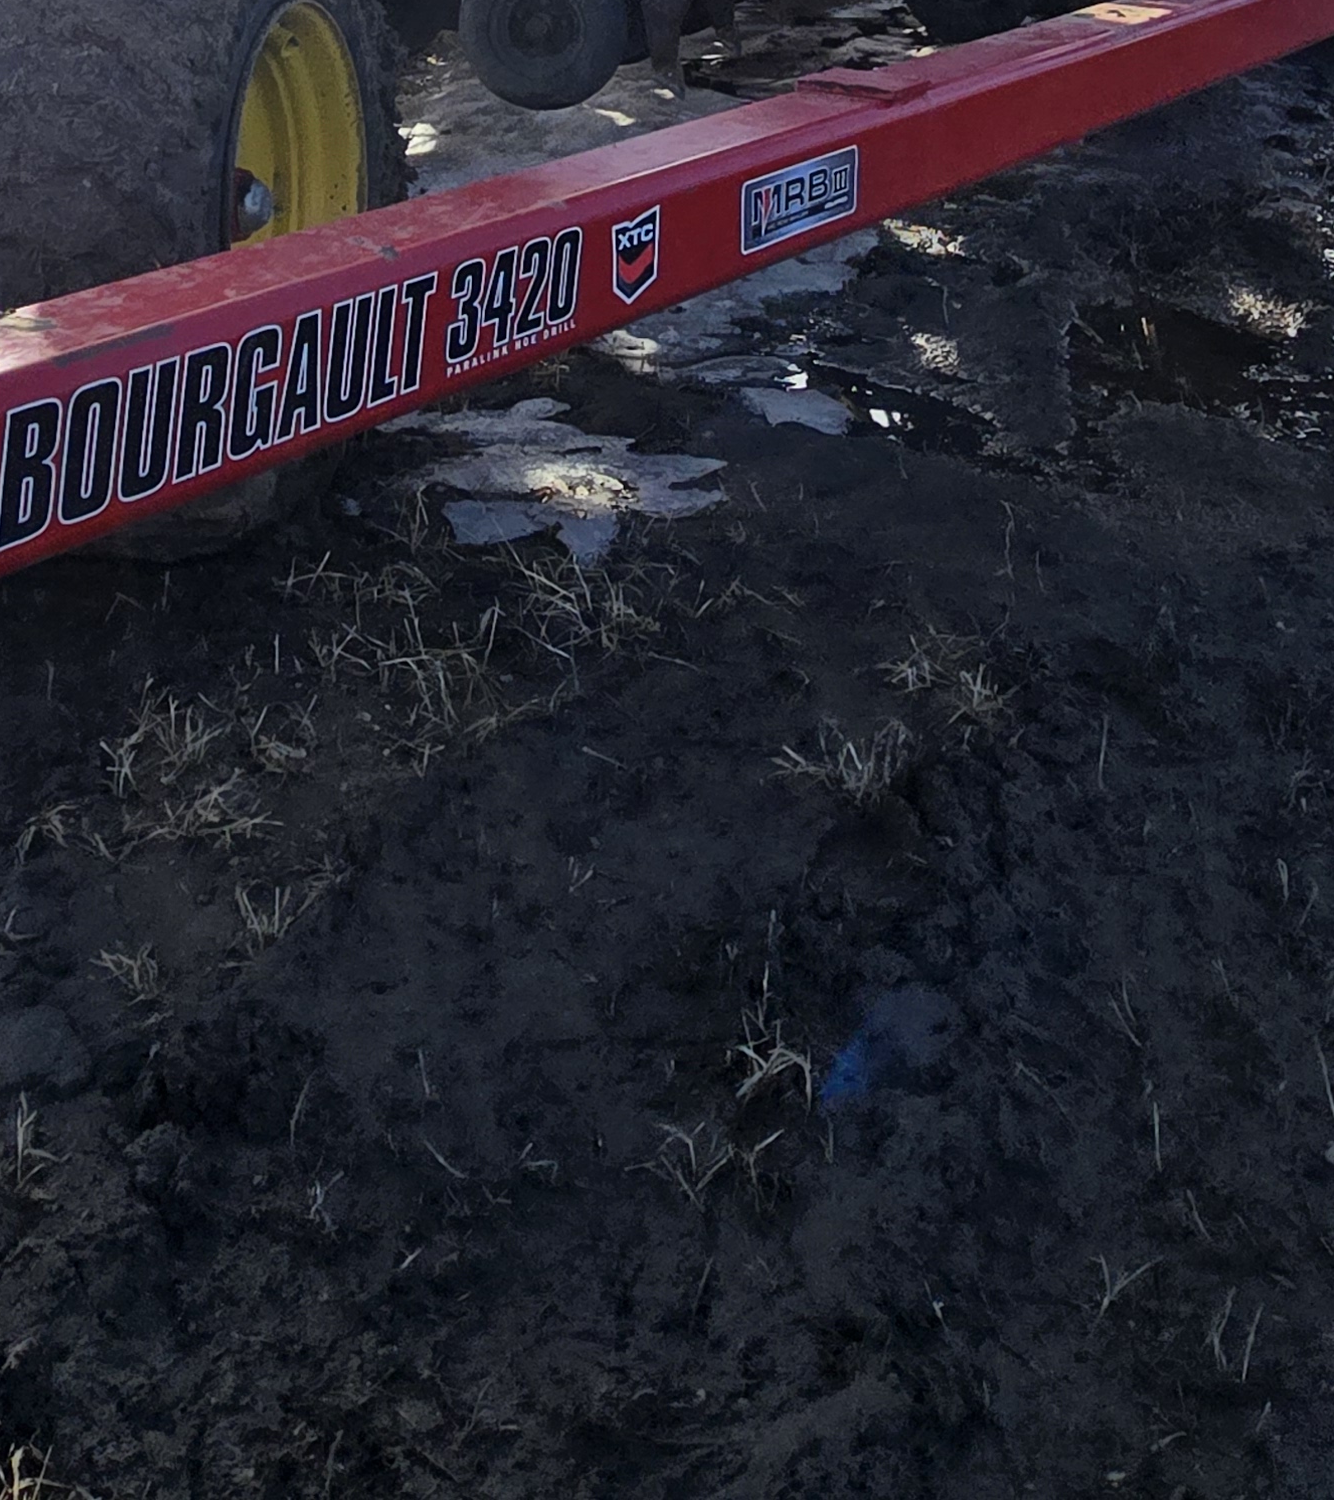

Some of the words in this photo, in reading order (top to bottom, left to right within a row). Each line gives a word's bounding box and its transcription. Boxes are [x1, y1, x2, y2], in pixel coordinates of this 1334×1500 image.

[751, 165, 830, 228] MRB
[618, 223, 654, 250] XTC
[446, 226, 583, 363] 3420
[447, 345, 508, 378] PARALINK
[515, 334, 537, 350] HOE
[543, 319, 576, 340] DRILL
